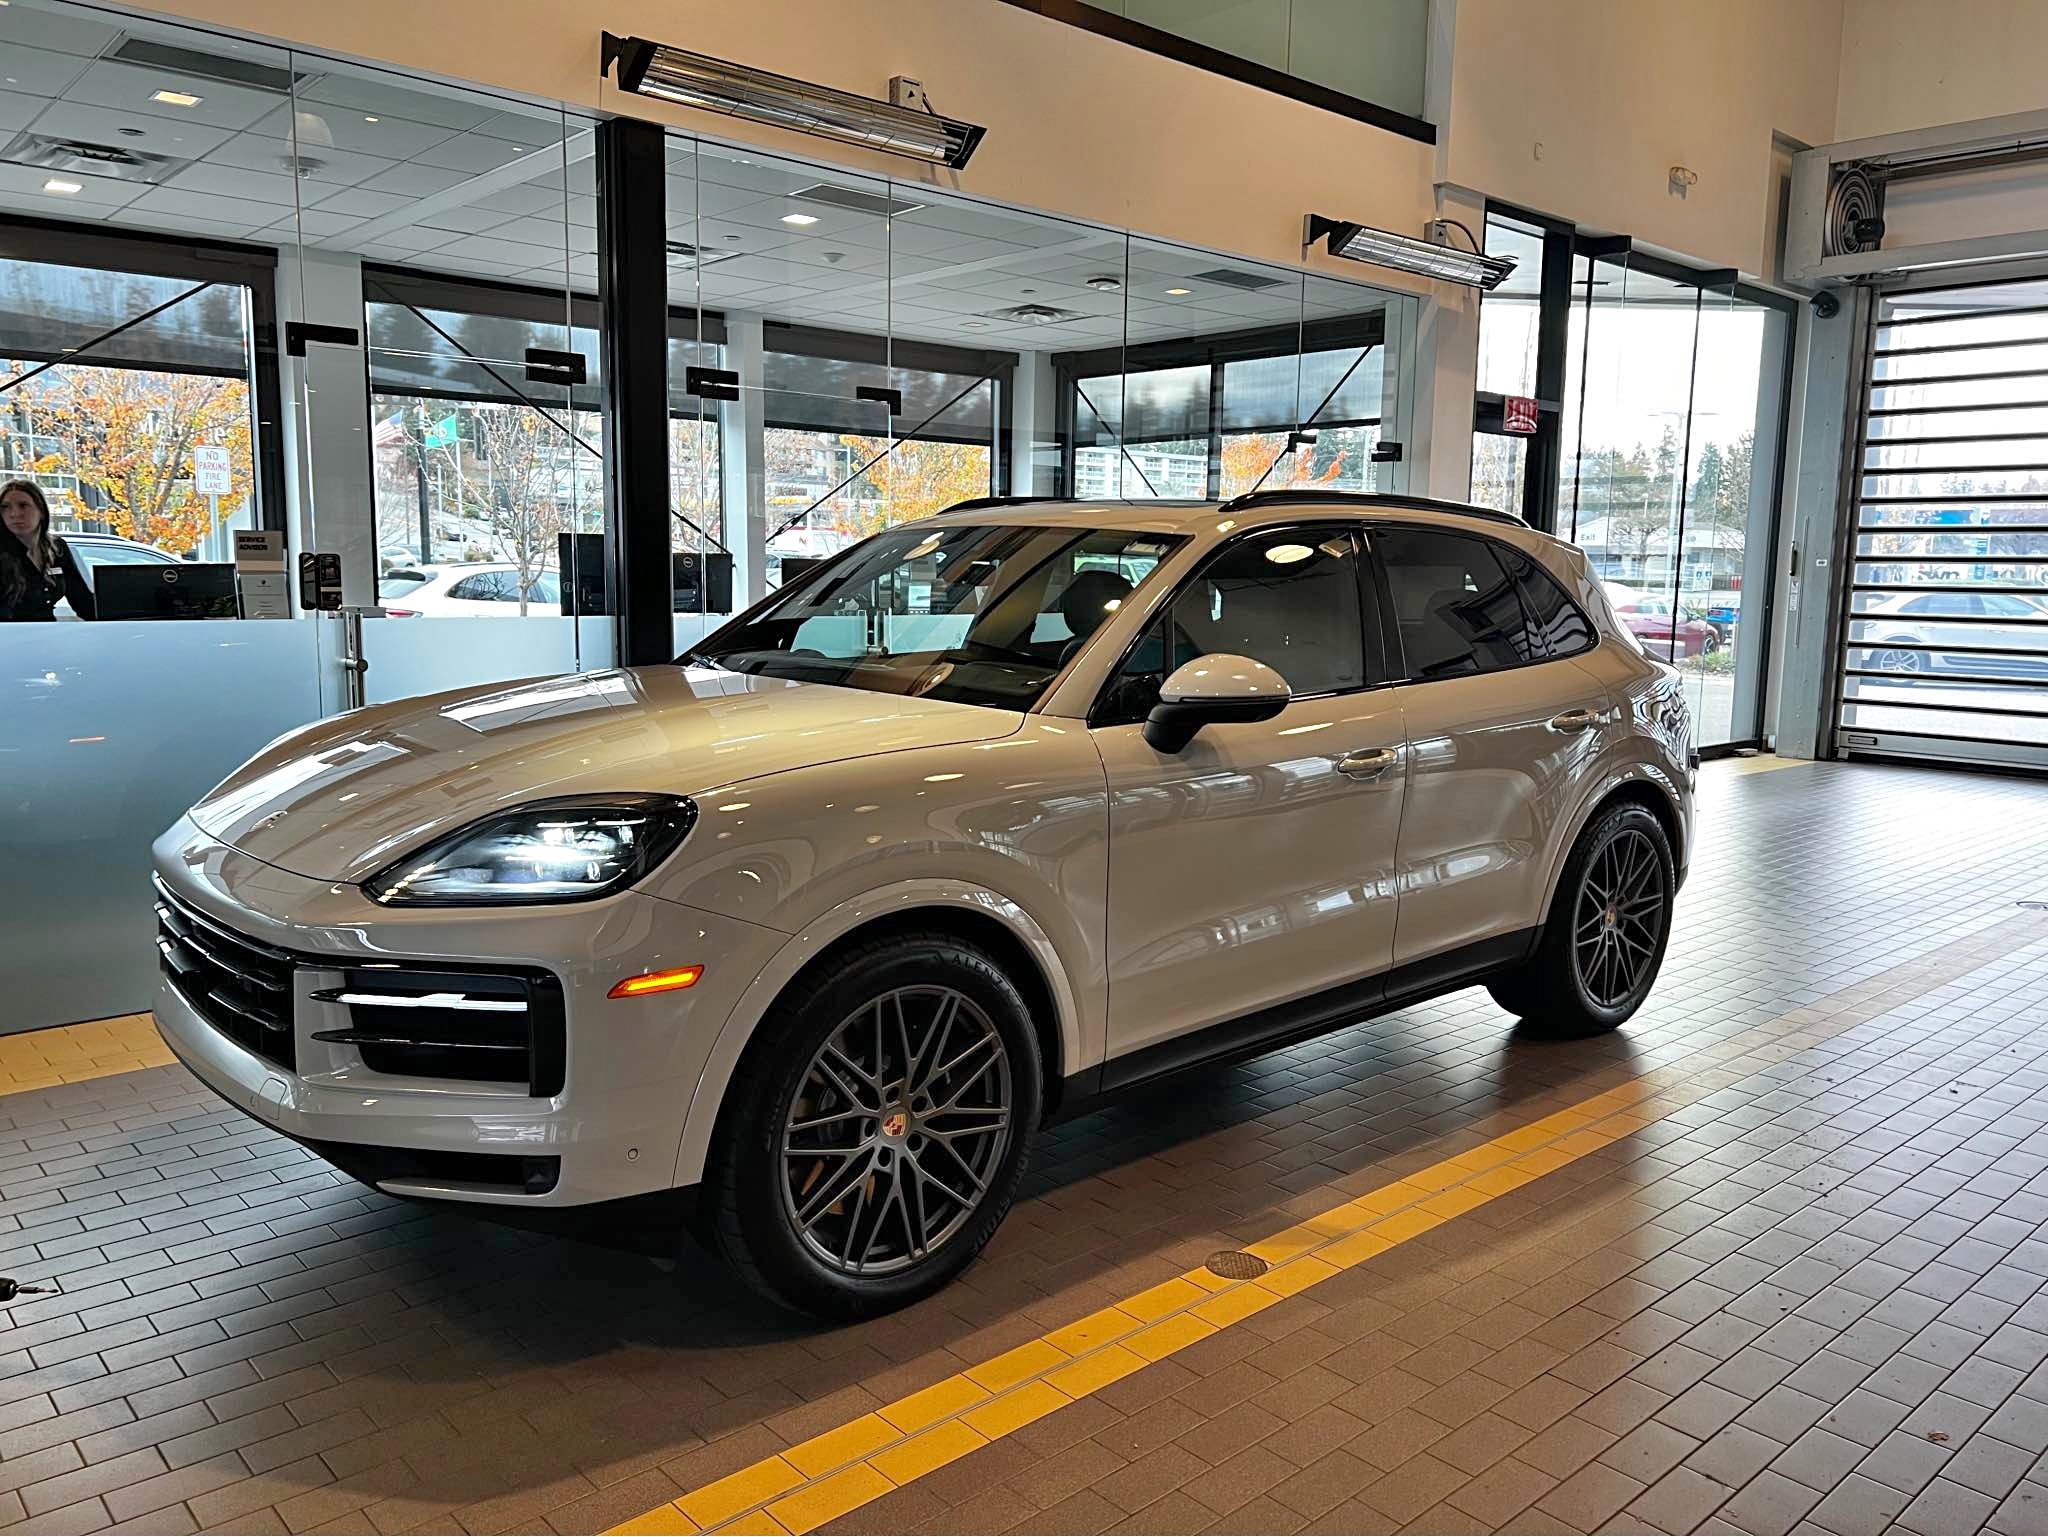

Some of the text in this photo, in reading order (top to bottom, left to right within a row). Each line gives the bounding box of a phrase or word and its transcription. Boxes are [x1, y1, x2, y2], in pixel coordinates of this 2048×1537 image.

[206, 451, 219, 461] NO
[199, 461, 227, 471] PARKING
[205, 472, 222, 480] FIRE
[205, 481, 223, 489] LANE
